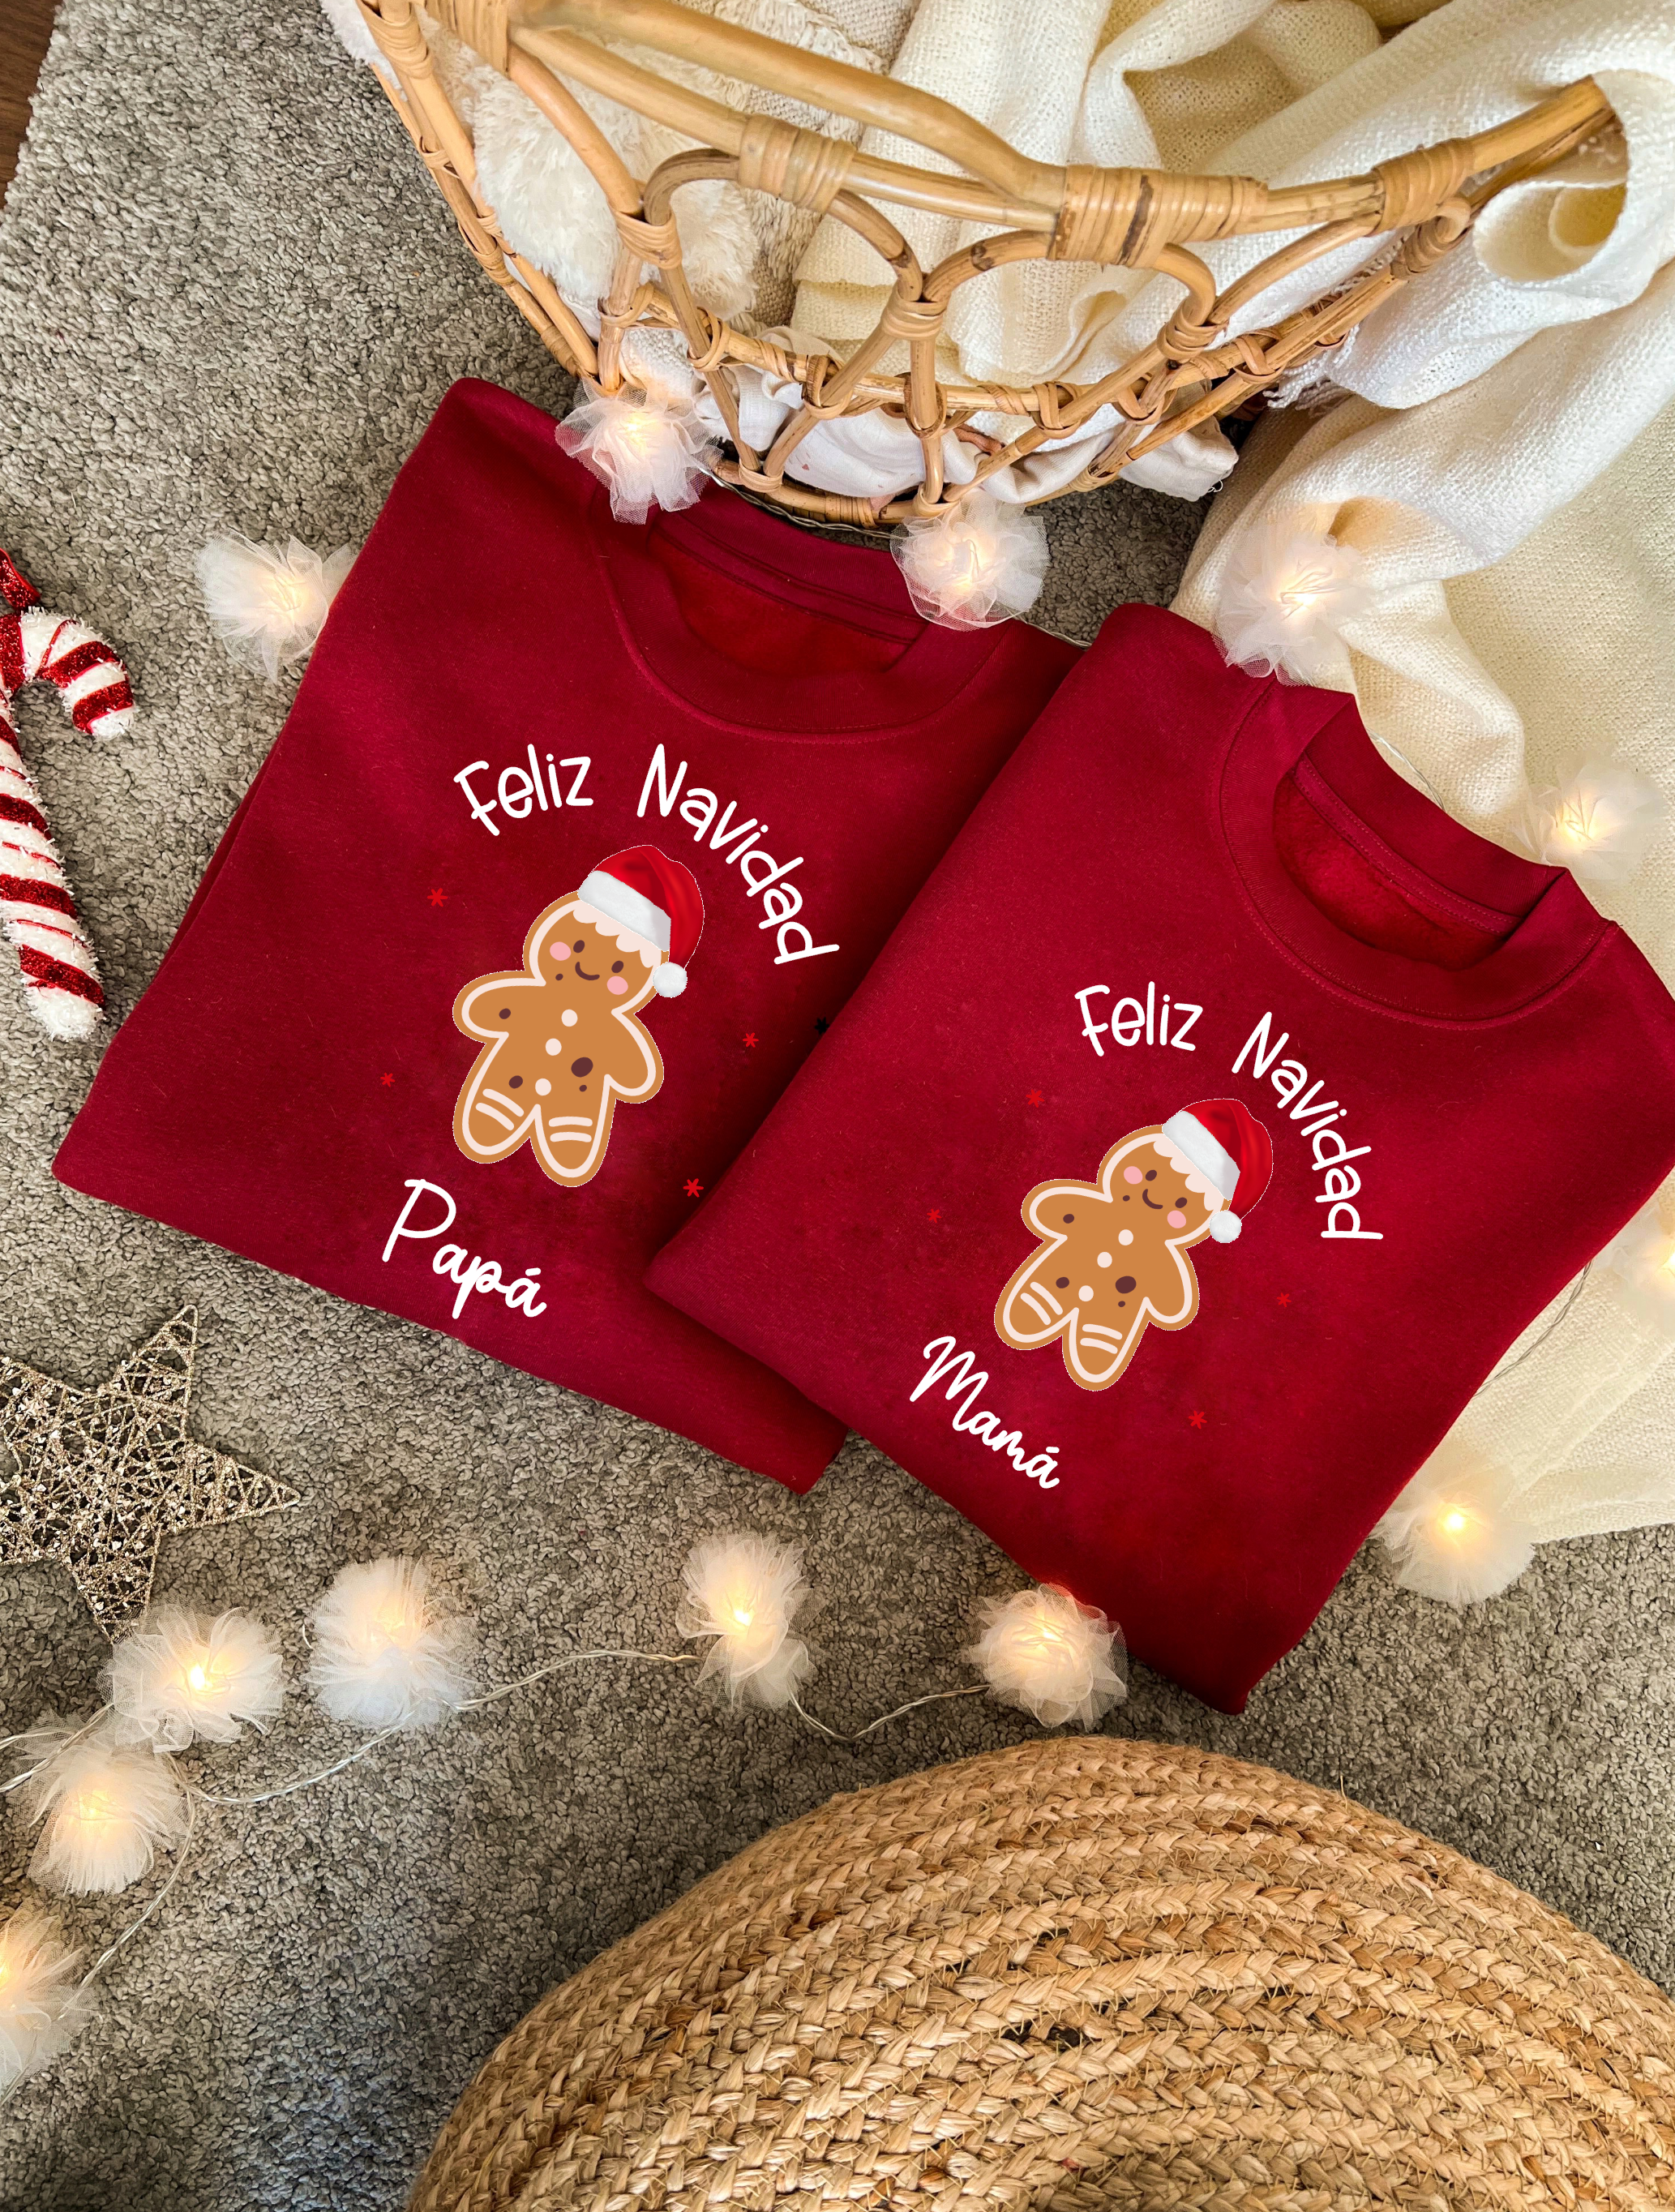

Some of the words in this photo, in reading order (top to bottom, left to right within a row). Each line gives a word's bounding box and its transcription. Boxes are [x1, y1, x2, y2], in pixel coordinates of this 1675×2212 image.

[454, 744, 593, 836] Feliz
[637, 744, 839, 965] Navidad
[1075, 981, 1203, 1057] Feliz
[1232, 1012, 1383, 1241] Navidad
[382, 1178, 547, 1320] Papá
[909, 1335, 1060, 1489] Mamá
